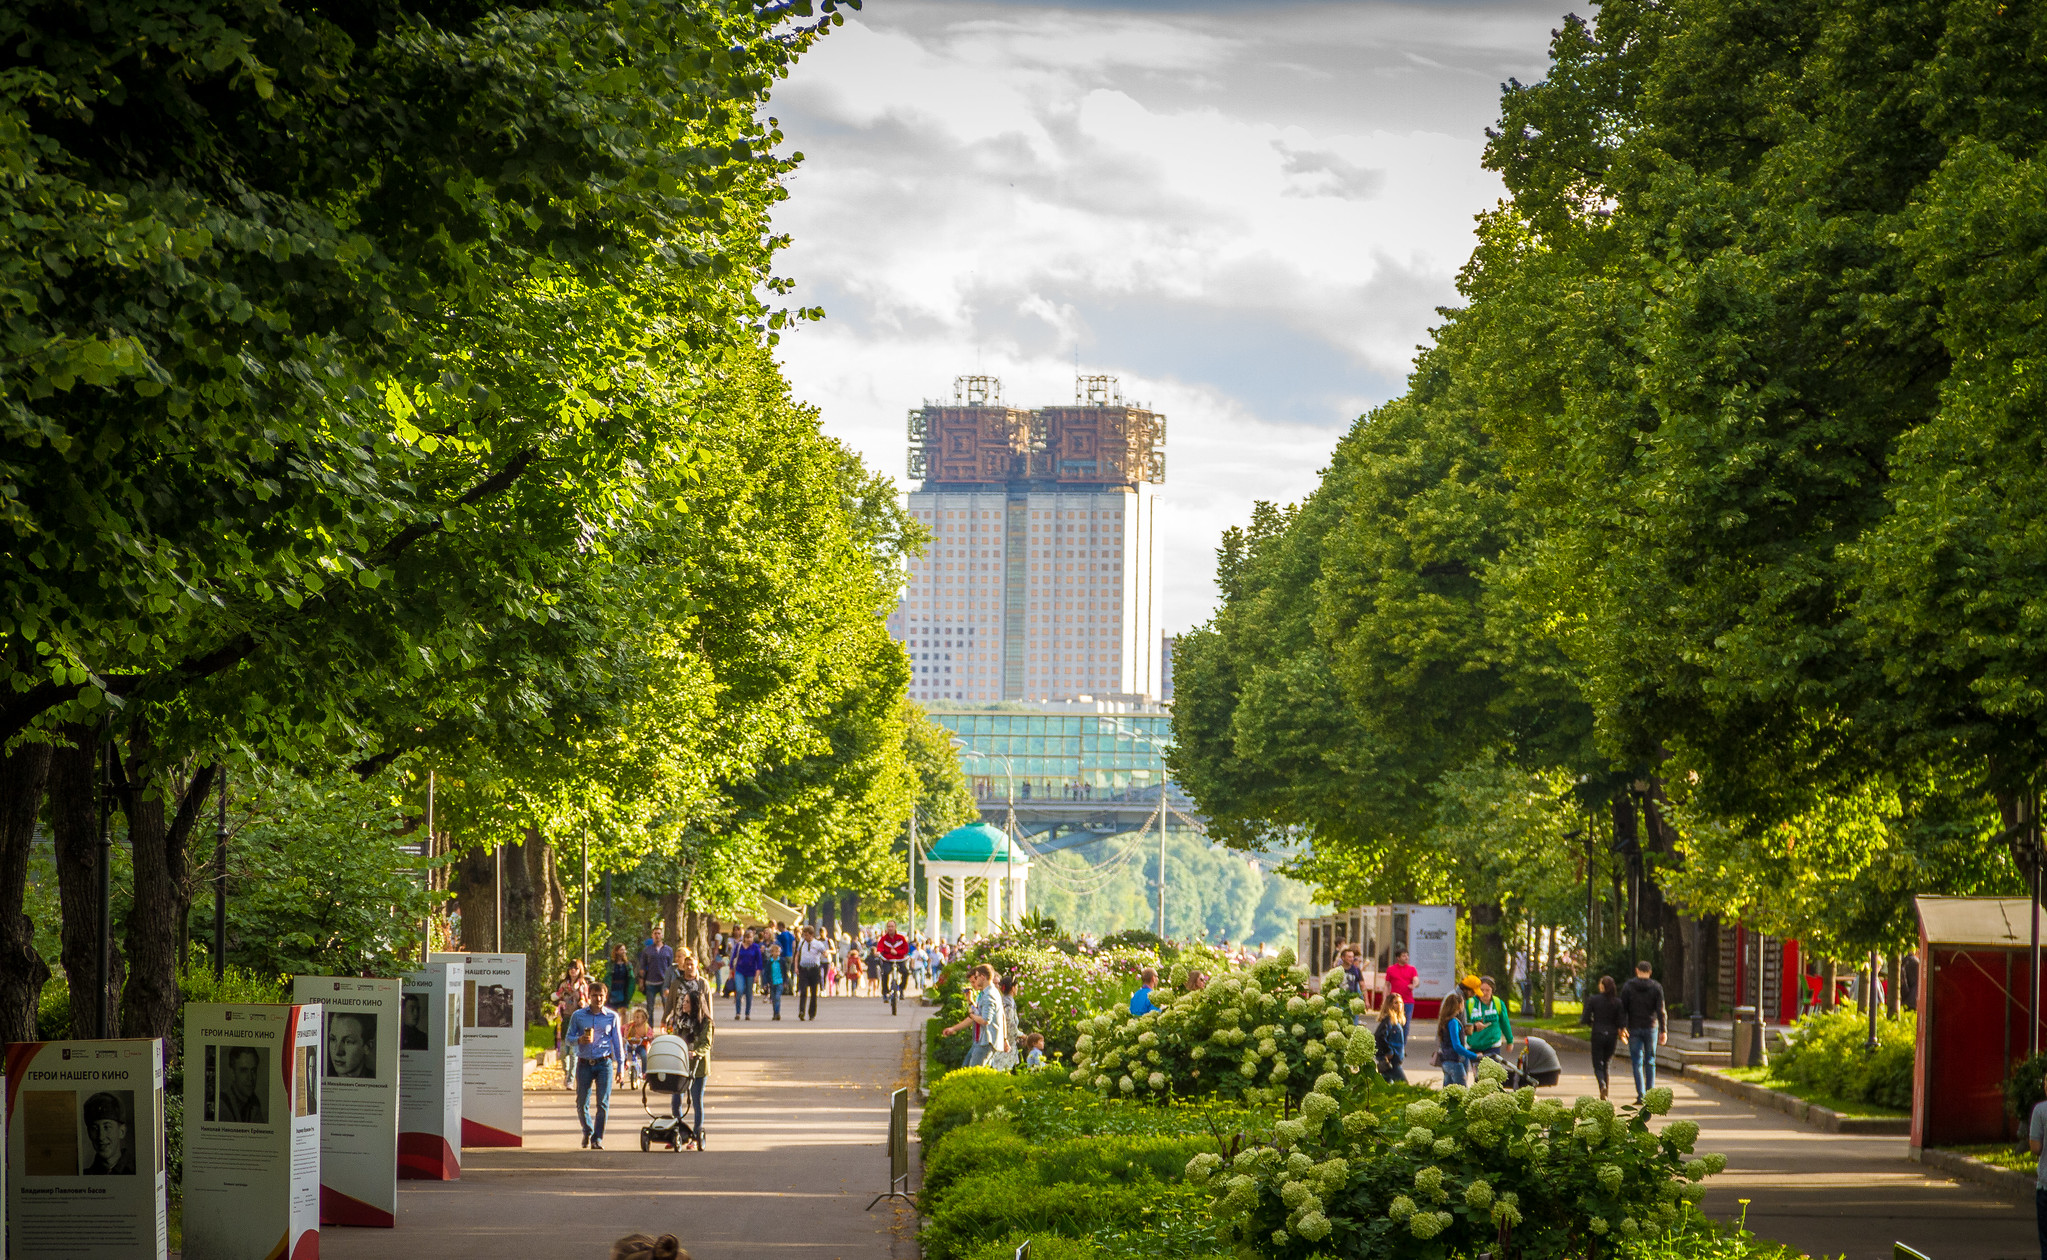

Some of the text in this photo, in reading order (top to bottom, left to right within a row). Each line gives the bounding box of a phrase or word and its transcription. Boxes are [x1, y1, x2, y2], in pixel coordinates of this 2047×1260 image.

[310, 997, 383, 1007] ГЕРОИ НАШЕГО КИНО
[201, 1028, 275, 1039] ГЕРОИ НАШЕГО КИНО
[28, 1070, 129, 1080] ГЕРОИ НАШЕГО КИНО
